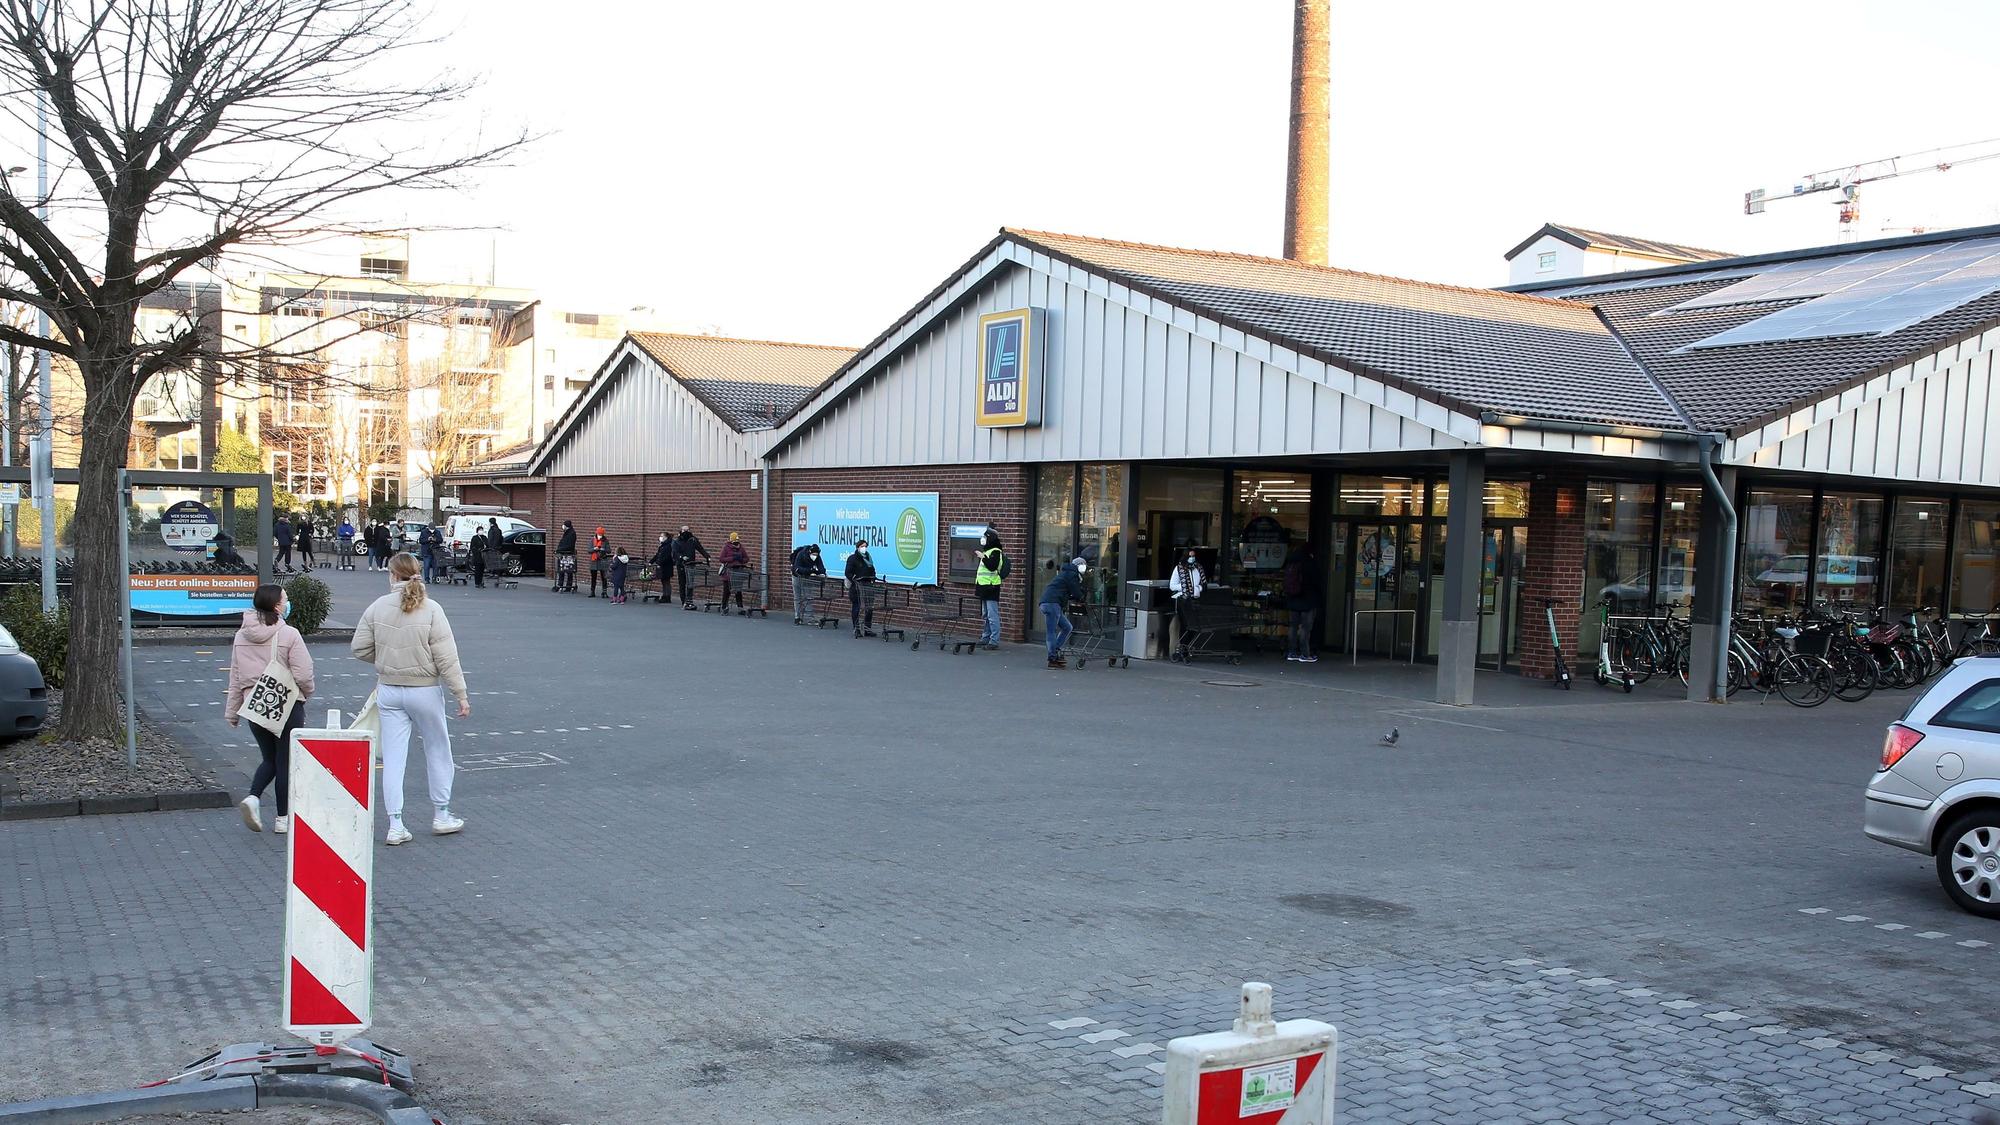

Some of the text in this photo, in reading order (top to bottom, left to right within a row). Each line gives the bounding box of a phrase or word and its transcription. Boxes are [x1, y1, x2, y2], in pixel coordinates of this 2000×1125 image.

[987, 382, 1016, 402] ALDI
[819, 524, 888, 547] KLIMANEUTRAL
[131, 578, 255, 588] Neu: Jetzt online bezahlen
[253, 685, 287, 713] BOX
